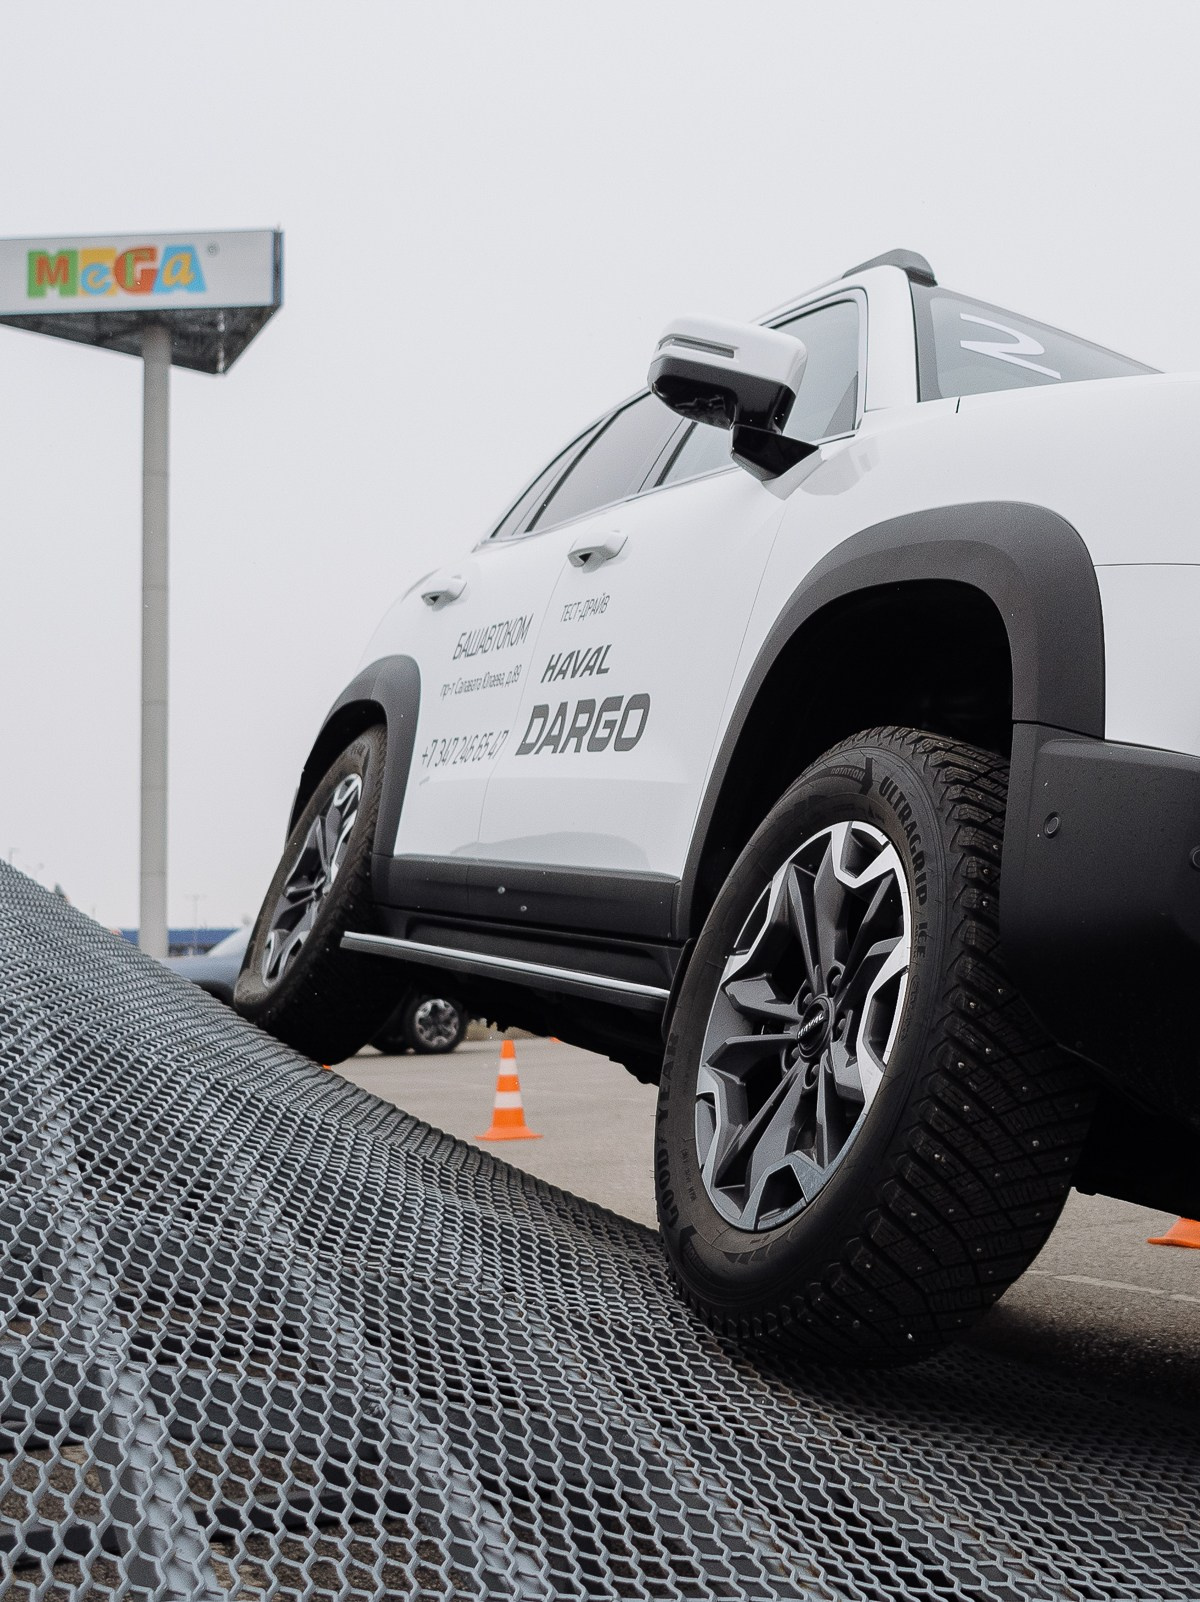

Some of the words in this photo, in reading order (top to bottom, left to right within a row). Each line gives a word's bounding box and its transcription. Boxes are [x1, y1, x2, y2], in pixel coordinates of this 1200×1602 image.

[560, 593, 611, 622] ТЕСТ-ДРАЙВ
[452, 613, 534, 660] БАШАВТОКОМ
[540, 644, 612, 683] HAVAL
[515, 693, 651, 756] DARGO
[878, 775, 928, 906] ULTRAGRIP
